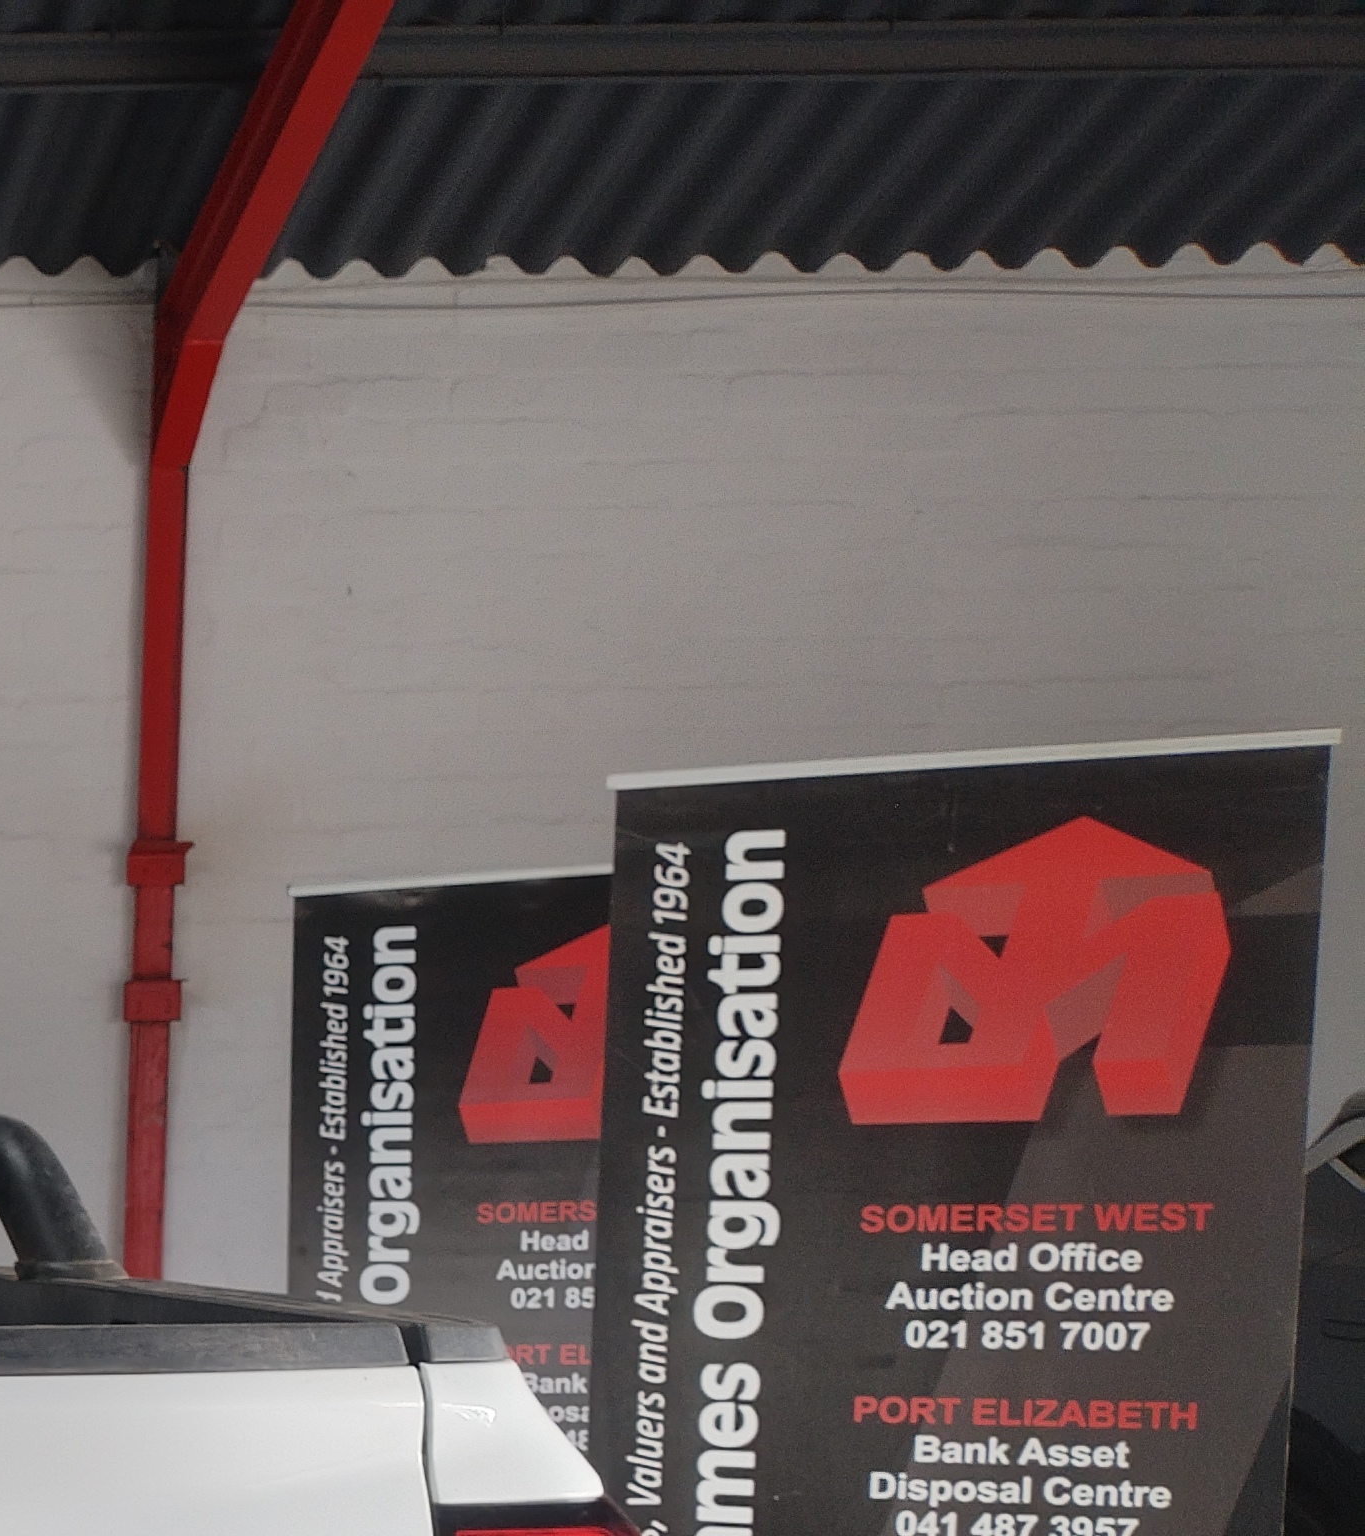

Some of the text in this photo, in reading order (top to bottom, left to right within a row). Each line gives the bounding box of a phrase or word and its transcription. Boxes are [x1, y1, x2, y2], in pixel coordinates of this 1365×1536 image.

[652, 842, 691, 923] 1964
[323, 936, 349, 996] 1964
[643, 932, 686, 1118] Established
[319, 1002, 348, 1140] Established
[693, 830, 785, 1339] Organisation
[359, 925, 420, 1305] Organisation
[317, 1161, 349, 1288] Appraisers
[520, 1229, 589, 1252] Head
[634, 1146, 679, 1315] Appraisers
[862, 1203, 1212, 1232] SOMERSET WEST
[921, 1242, 1142, 1272] Head Office
[510, 1287, 555, 1310] 021
[885, 1282, 1174, 1311] Auction Centre
[632, 1320, 668, 1383] and
[906, 1320, 1150, 1351] 021 851 7007
[854, 1396, 1197, 1429] PORT ELIZABETH
[626, 1391, 665, 1505] Valuers
[914, 1435, 1129, 1468] Bank Asset
[870, 1472, 1171, 1508] Disposal Centre
